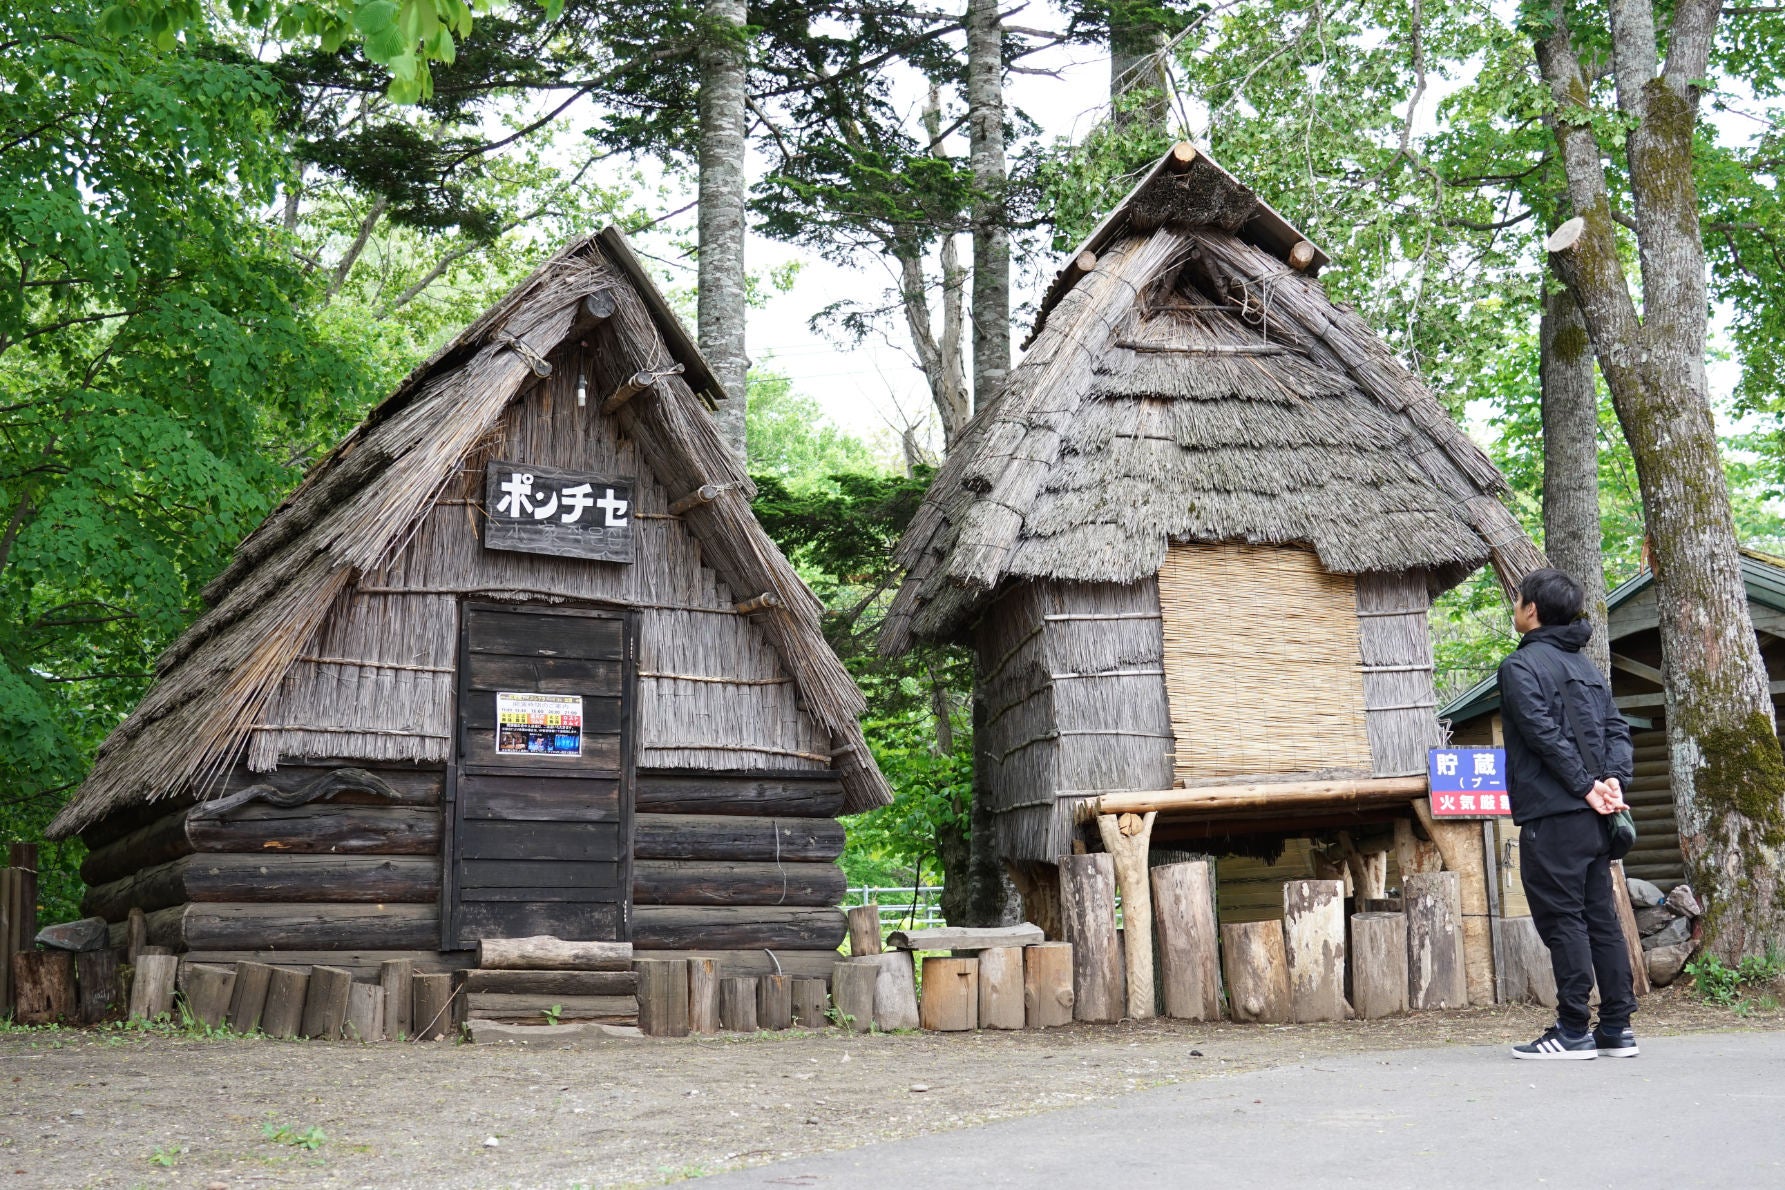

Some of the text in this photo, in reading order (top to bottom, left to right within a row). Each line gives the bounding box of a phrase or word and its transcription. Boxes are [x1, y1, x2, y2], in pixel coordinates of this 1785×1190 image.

[496, 473, 628, 527] ポンチセ
[1436, 753, 1496, 776] 貯蔵
